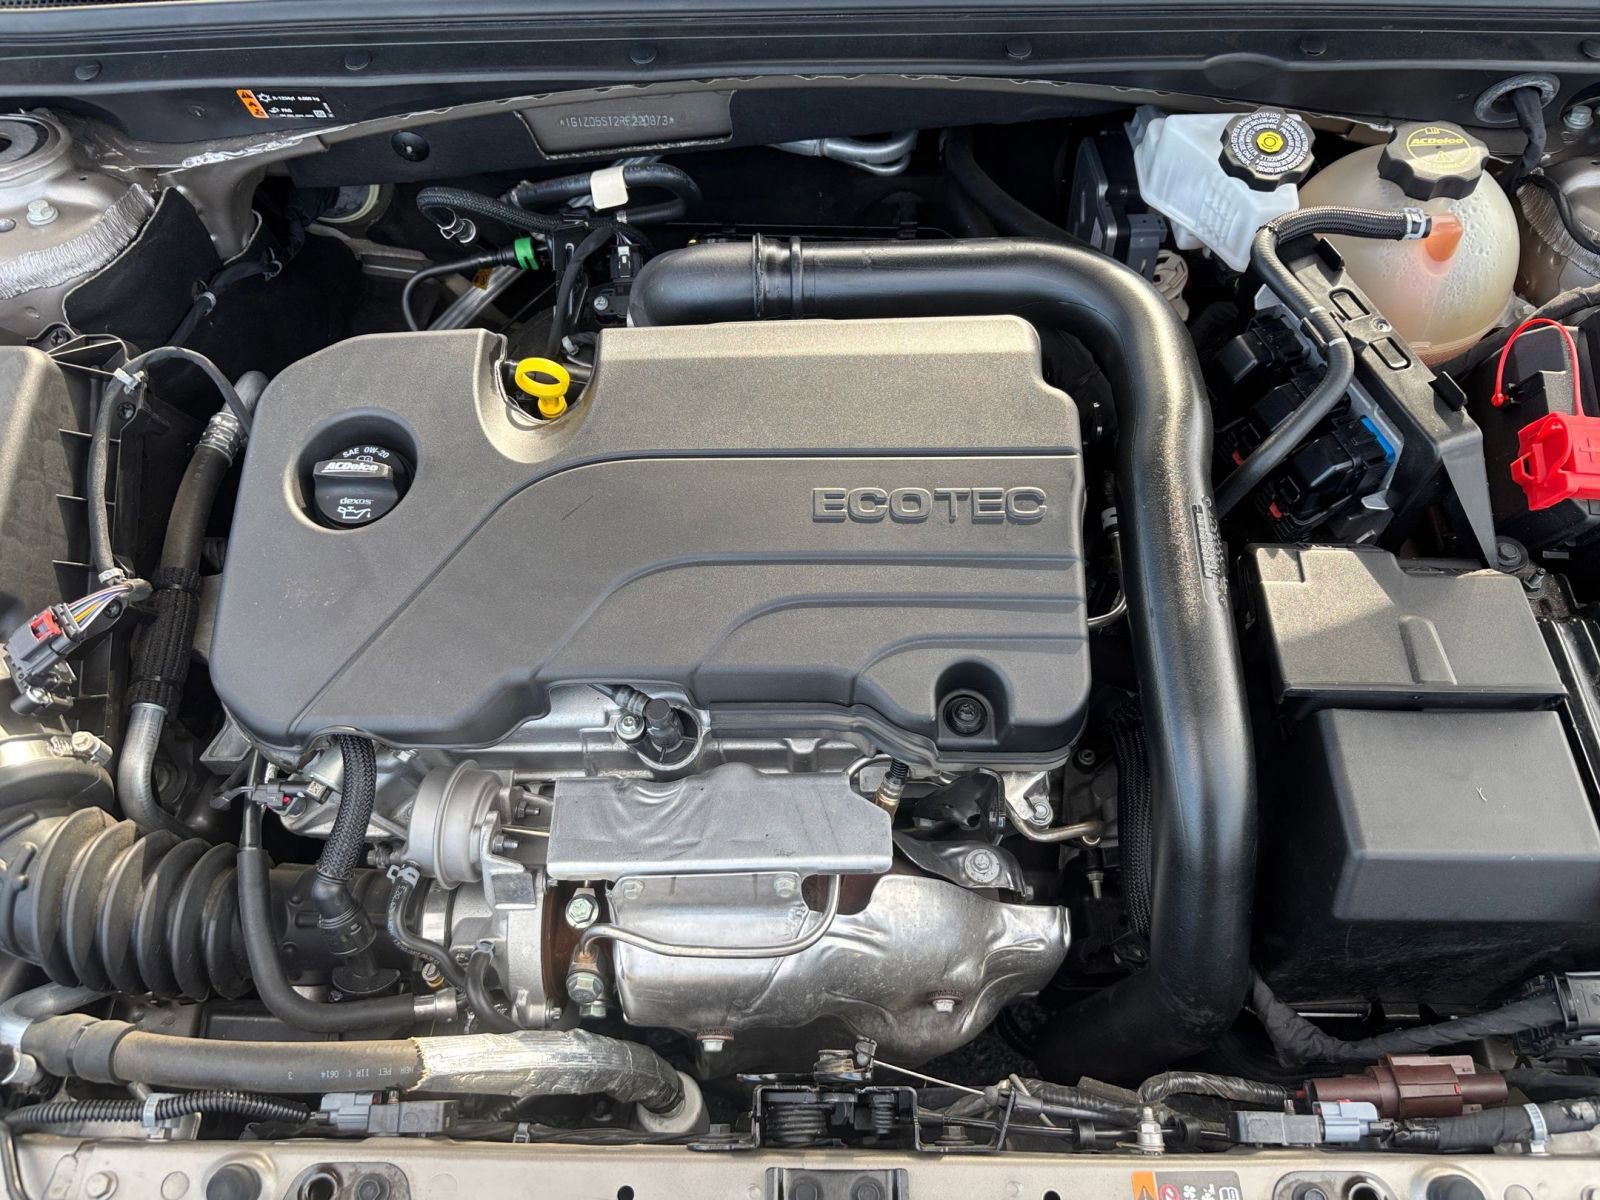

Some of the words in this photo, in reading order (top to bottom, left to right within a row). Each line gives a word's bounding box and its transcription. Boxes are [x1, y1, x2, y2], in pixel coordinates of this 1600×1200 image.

[1410, 137, 1464, 146] ACDelco
[342, 447, 360, 458] SAE
[363, 446, 390, 459] 0W-20
[323, 461, 379, 472] ACDelco
[339, 497, 373, 505] dexos
[812, 486, 1048, 524] ECOTEC
